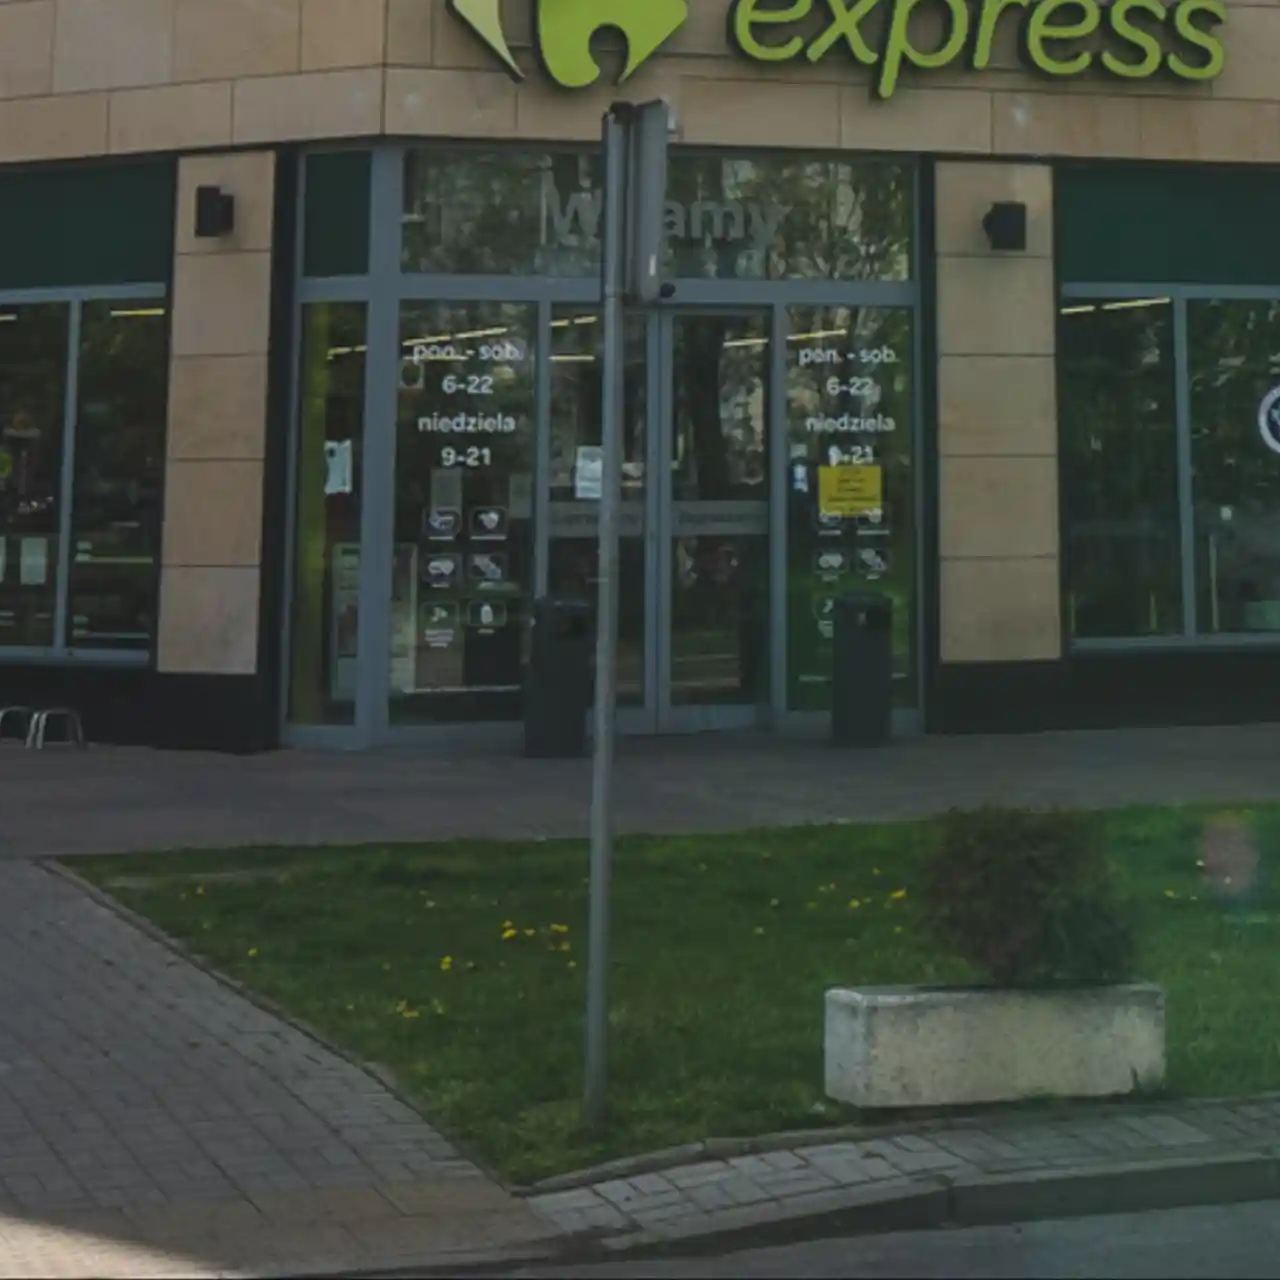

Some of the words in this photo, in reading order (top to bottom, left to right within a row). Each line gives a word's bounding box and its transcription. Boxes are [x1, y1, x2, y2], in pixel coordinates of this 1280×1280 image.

[441, 374, 495, 395] 6-22
[826, 376, 874, 397] 6-22
[417, 411, 517, 433] niedziela
[805, 411, 897, 433] niedziela
[441, 445, 493, 467] 9-21
